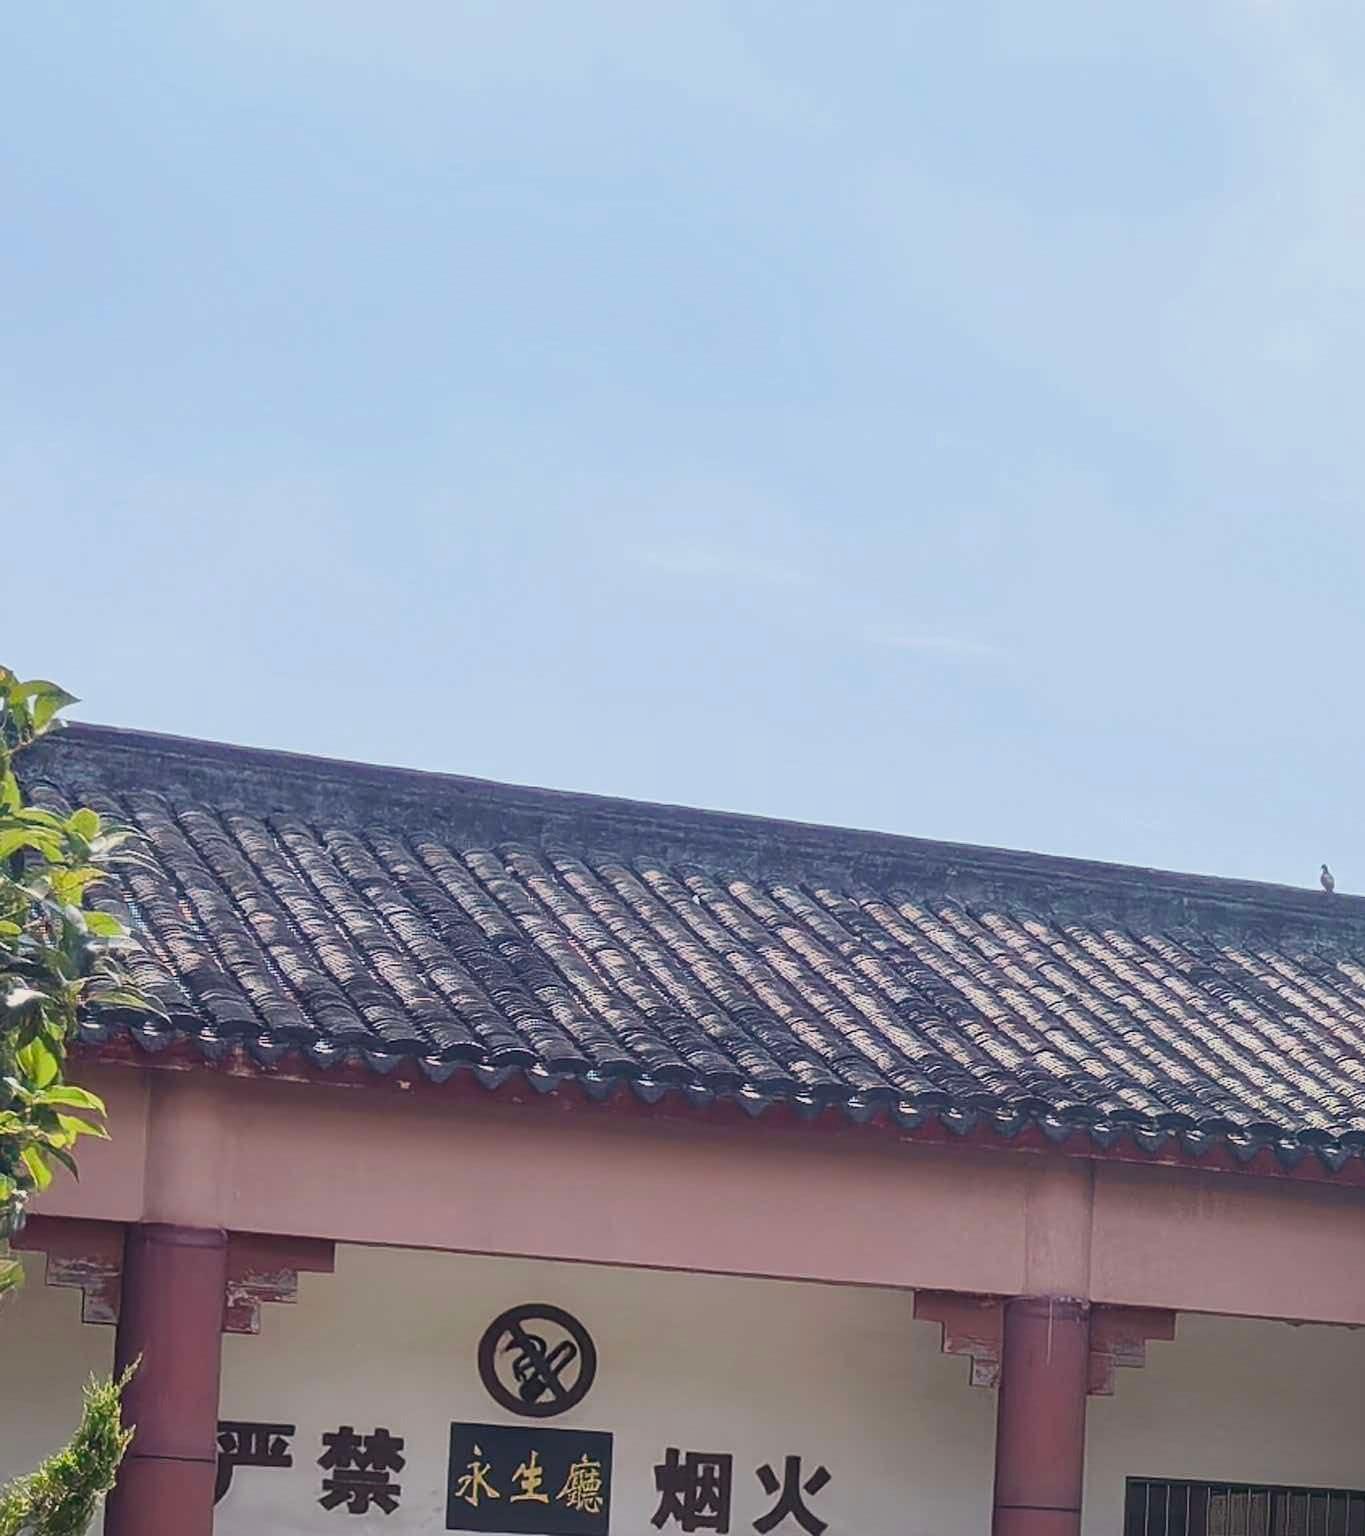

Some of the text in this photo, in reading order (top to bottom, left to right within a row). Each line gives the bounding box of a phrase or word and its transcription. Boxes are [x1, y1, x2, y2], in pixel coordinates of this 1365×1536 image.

[214, 1420, 832, 1536] 严禁 烟火
[455, 1443, 603, 1515] 永生廳
